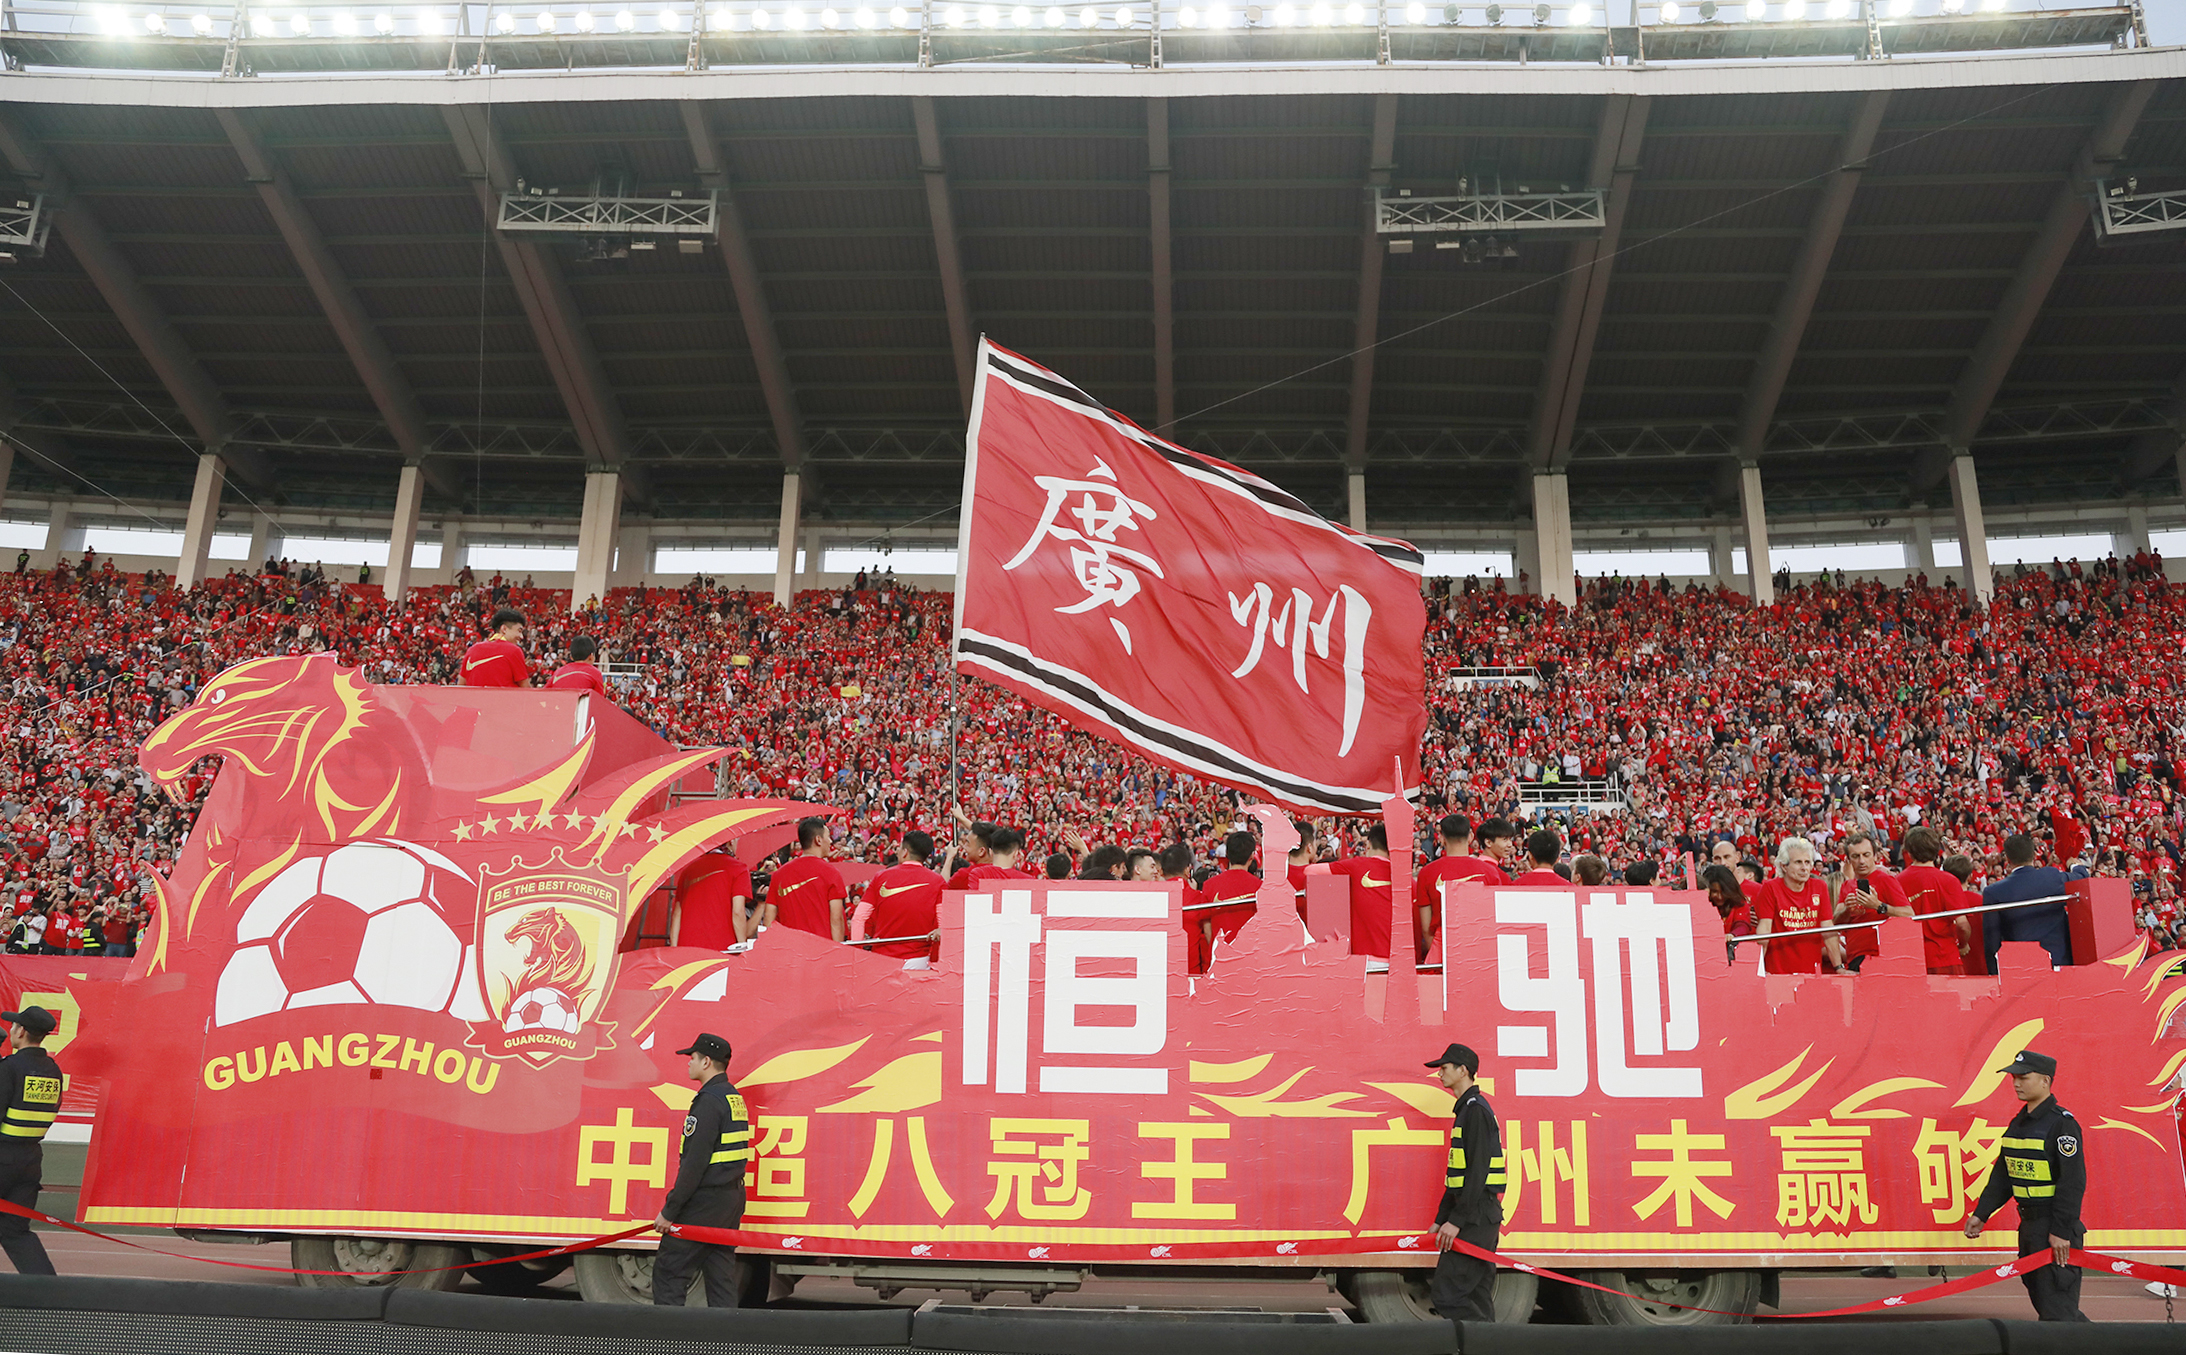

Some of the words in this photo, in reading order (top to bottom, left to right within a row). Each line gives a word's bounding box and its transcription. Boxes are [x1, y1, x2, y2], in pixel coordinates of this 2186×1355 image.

[1002, 455, 1372, 759] 廣州
[493, 888, 511, 902] BE
[514, 882, 536, 896] THE
[538, 880, 565, 892] BEST
[567, 881, 613, 902] FOREVER
[203, 1031, 500, 1094] GUANGZHOU
[503, 1033, 577, 1050] GUANGZHOU
[26, 1079, 59, 1092] 天河安保
[576, 1106, 1237, 1220] 中超八冠王
[1342, 1117, 2009, 1228] 广州未赢够
